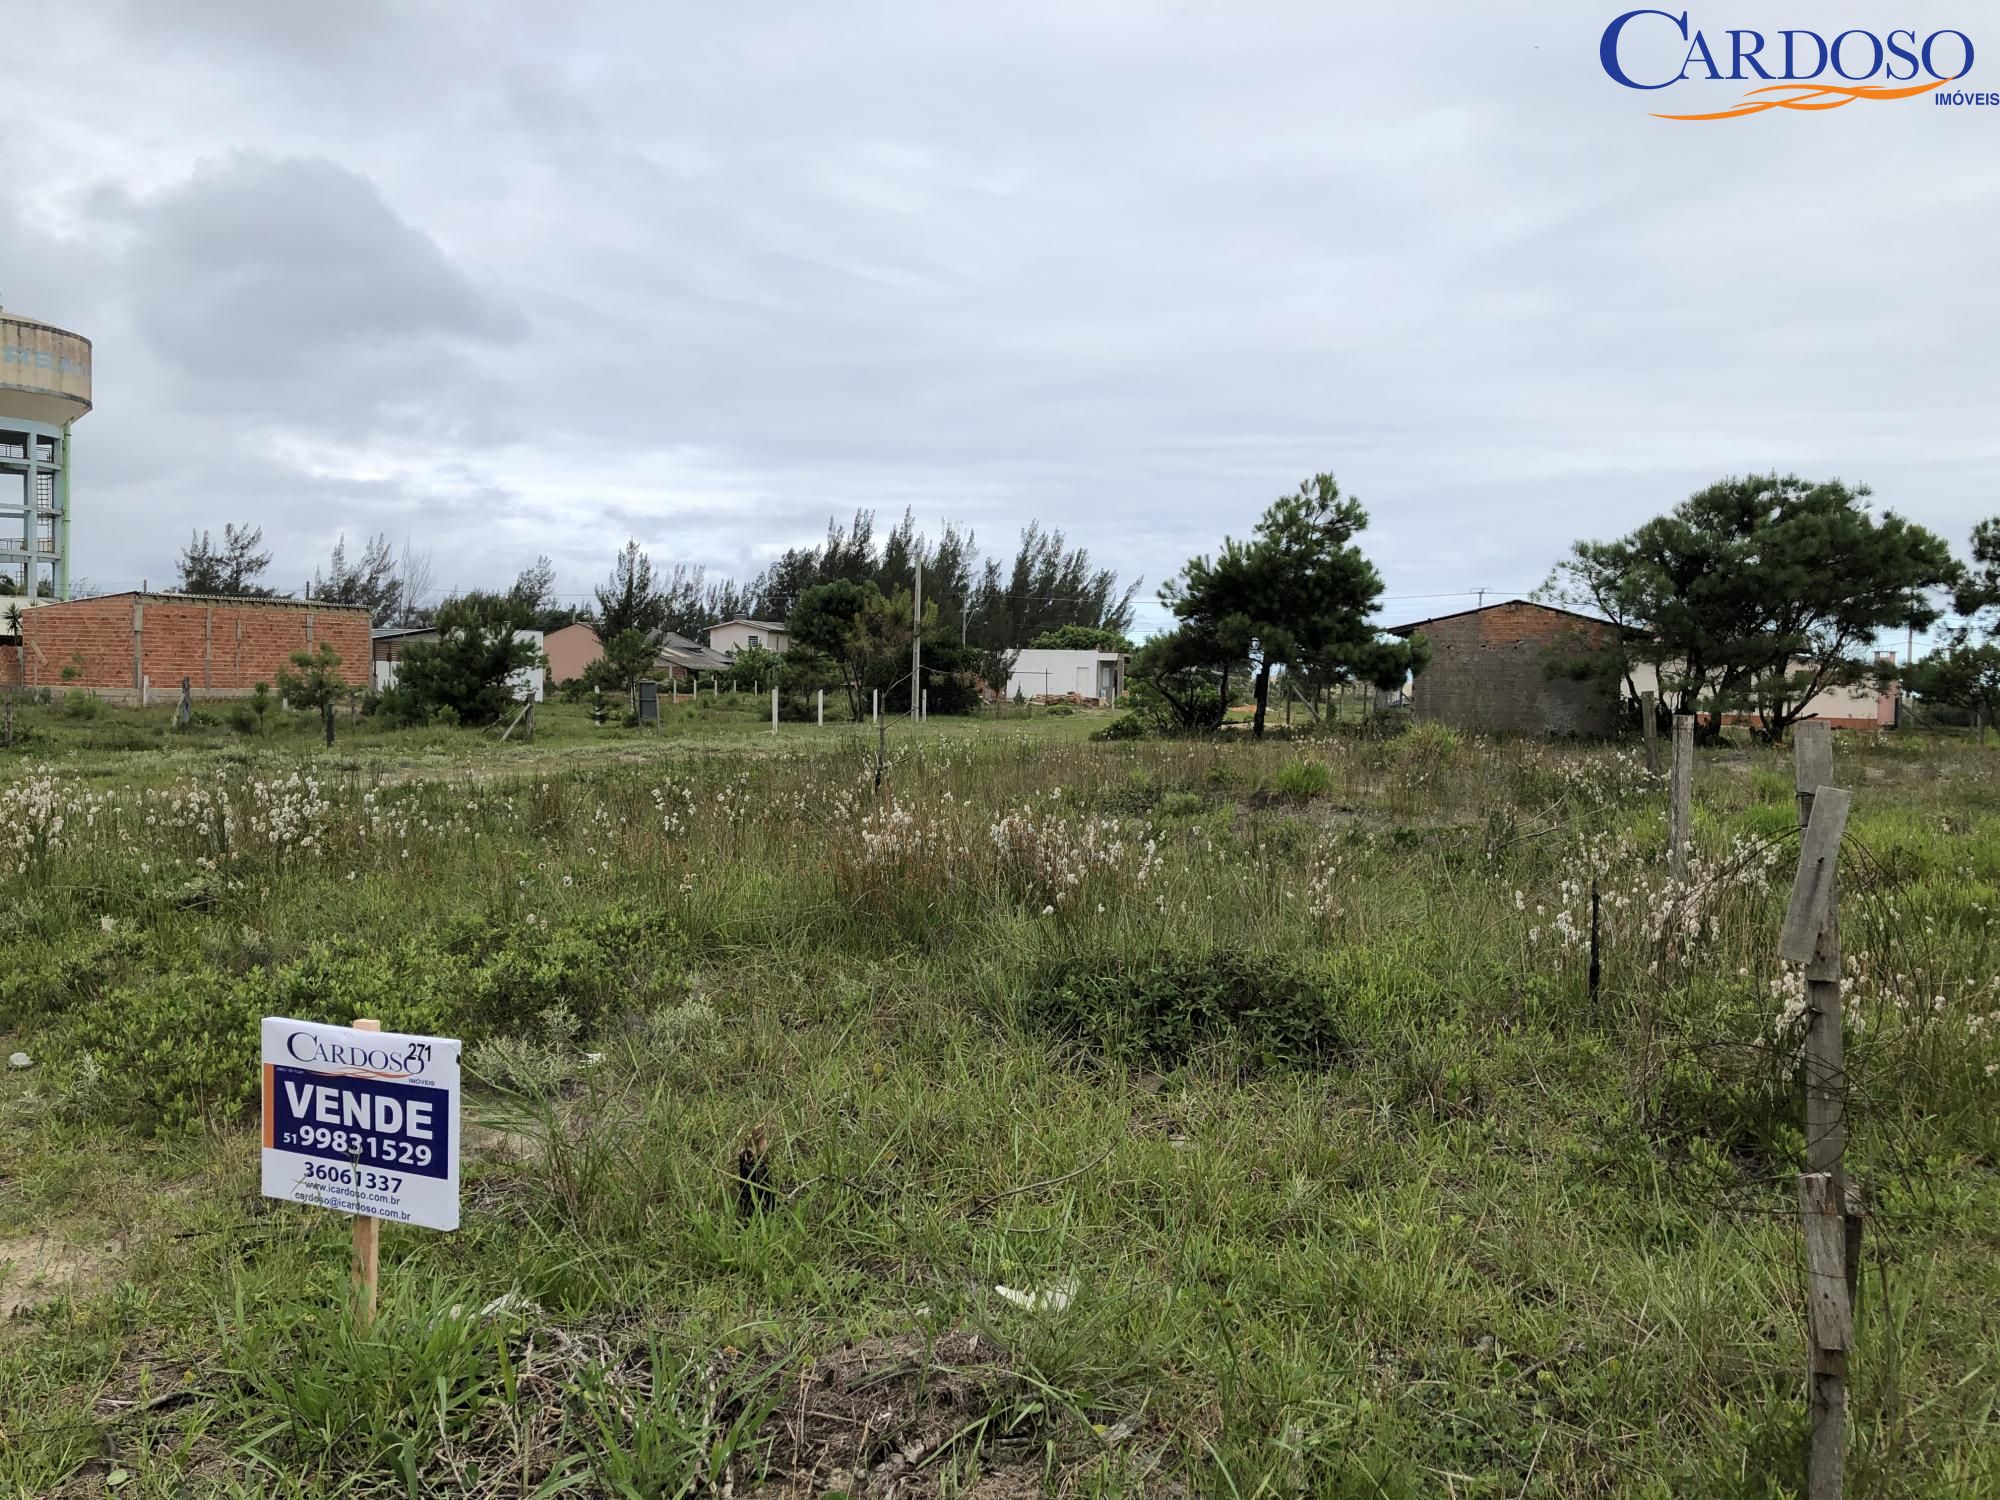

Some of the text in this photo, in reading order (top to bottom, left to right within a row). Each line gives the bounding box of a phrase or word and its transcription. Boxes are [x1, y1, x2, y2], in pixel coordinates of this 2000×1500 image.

[286, 1031, 425, 1075] CARDOSO
[407, 1042, 432, 1062] 271
[283, 1080, 433, 1140] VENDE
[283, 1125, 432, 1167] 51 99831529
[303, 1161, 403, 1194] 36061337
[304, 1181, 401, 1206] www.icardoso.com.br
[294, 1191, 412, 1221] cardoso@icardoso.com.br
